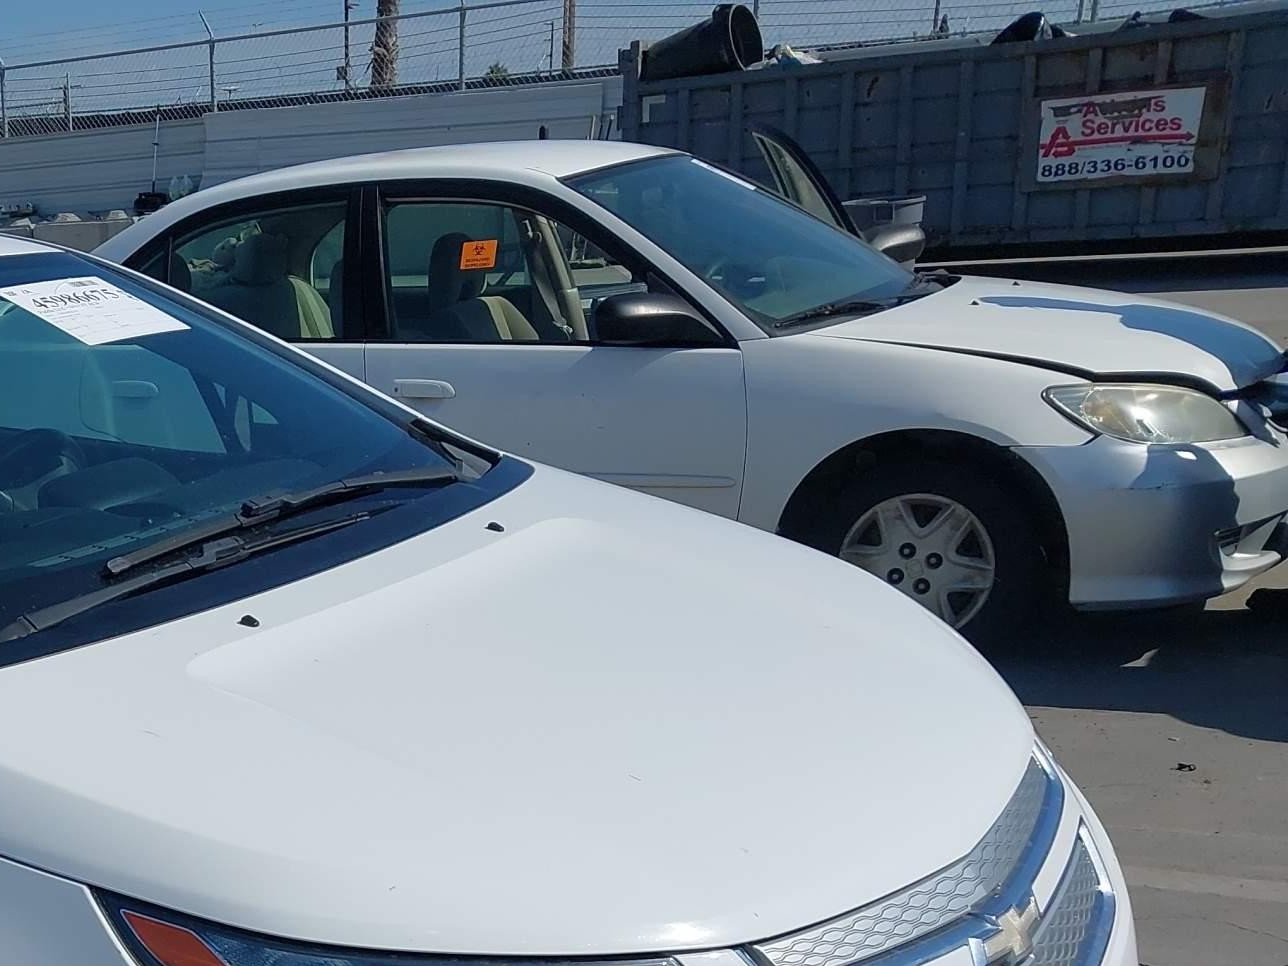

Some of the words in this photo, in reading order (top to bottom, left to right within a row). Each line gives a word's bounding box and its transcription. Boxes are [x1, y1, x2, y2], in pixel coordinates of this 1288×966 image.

[1081, 116, 1183, 138] Services
[1041, 154, 1190, 177] 888/336-6100
[31, 288, 120, 310] 45986675
